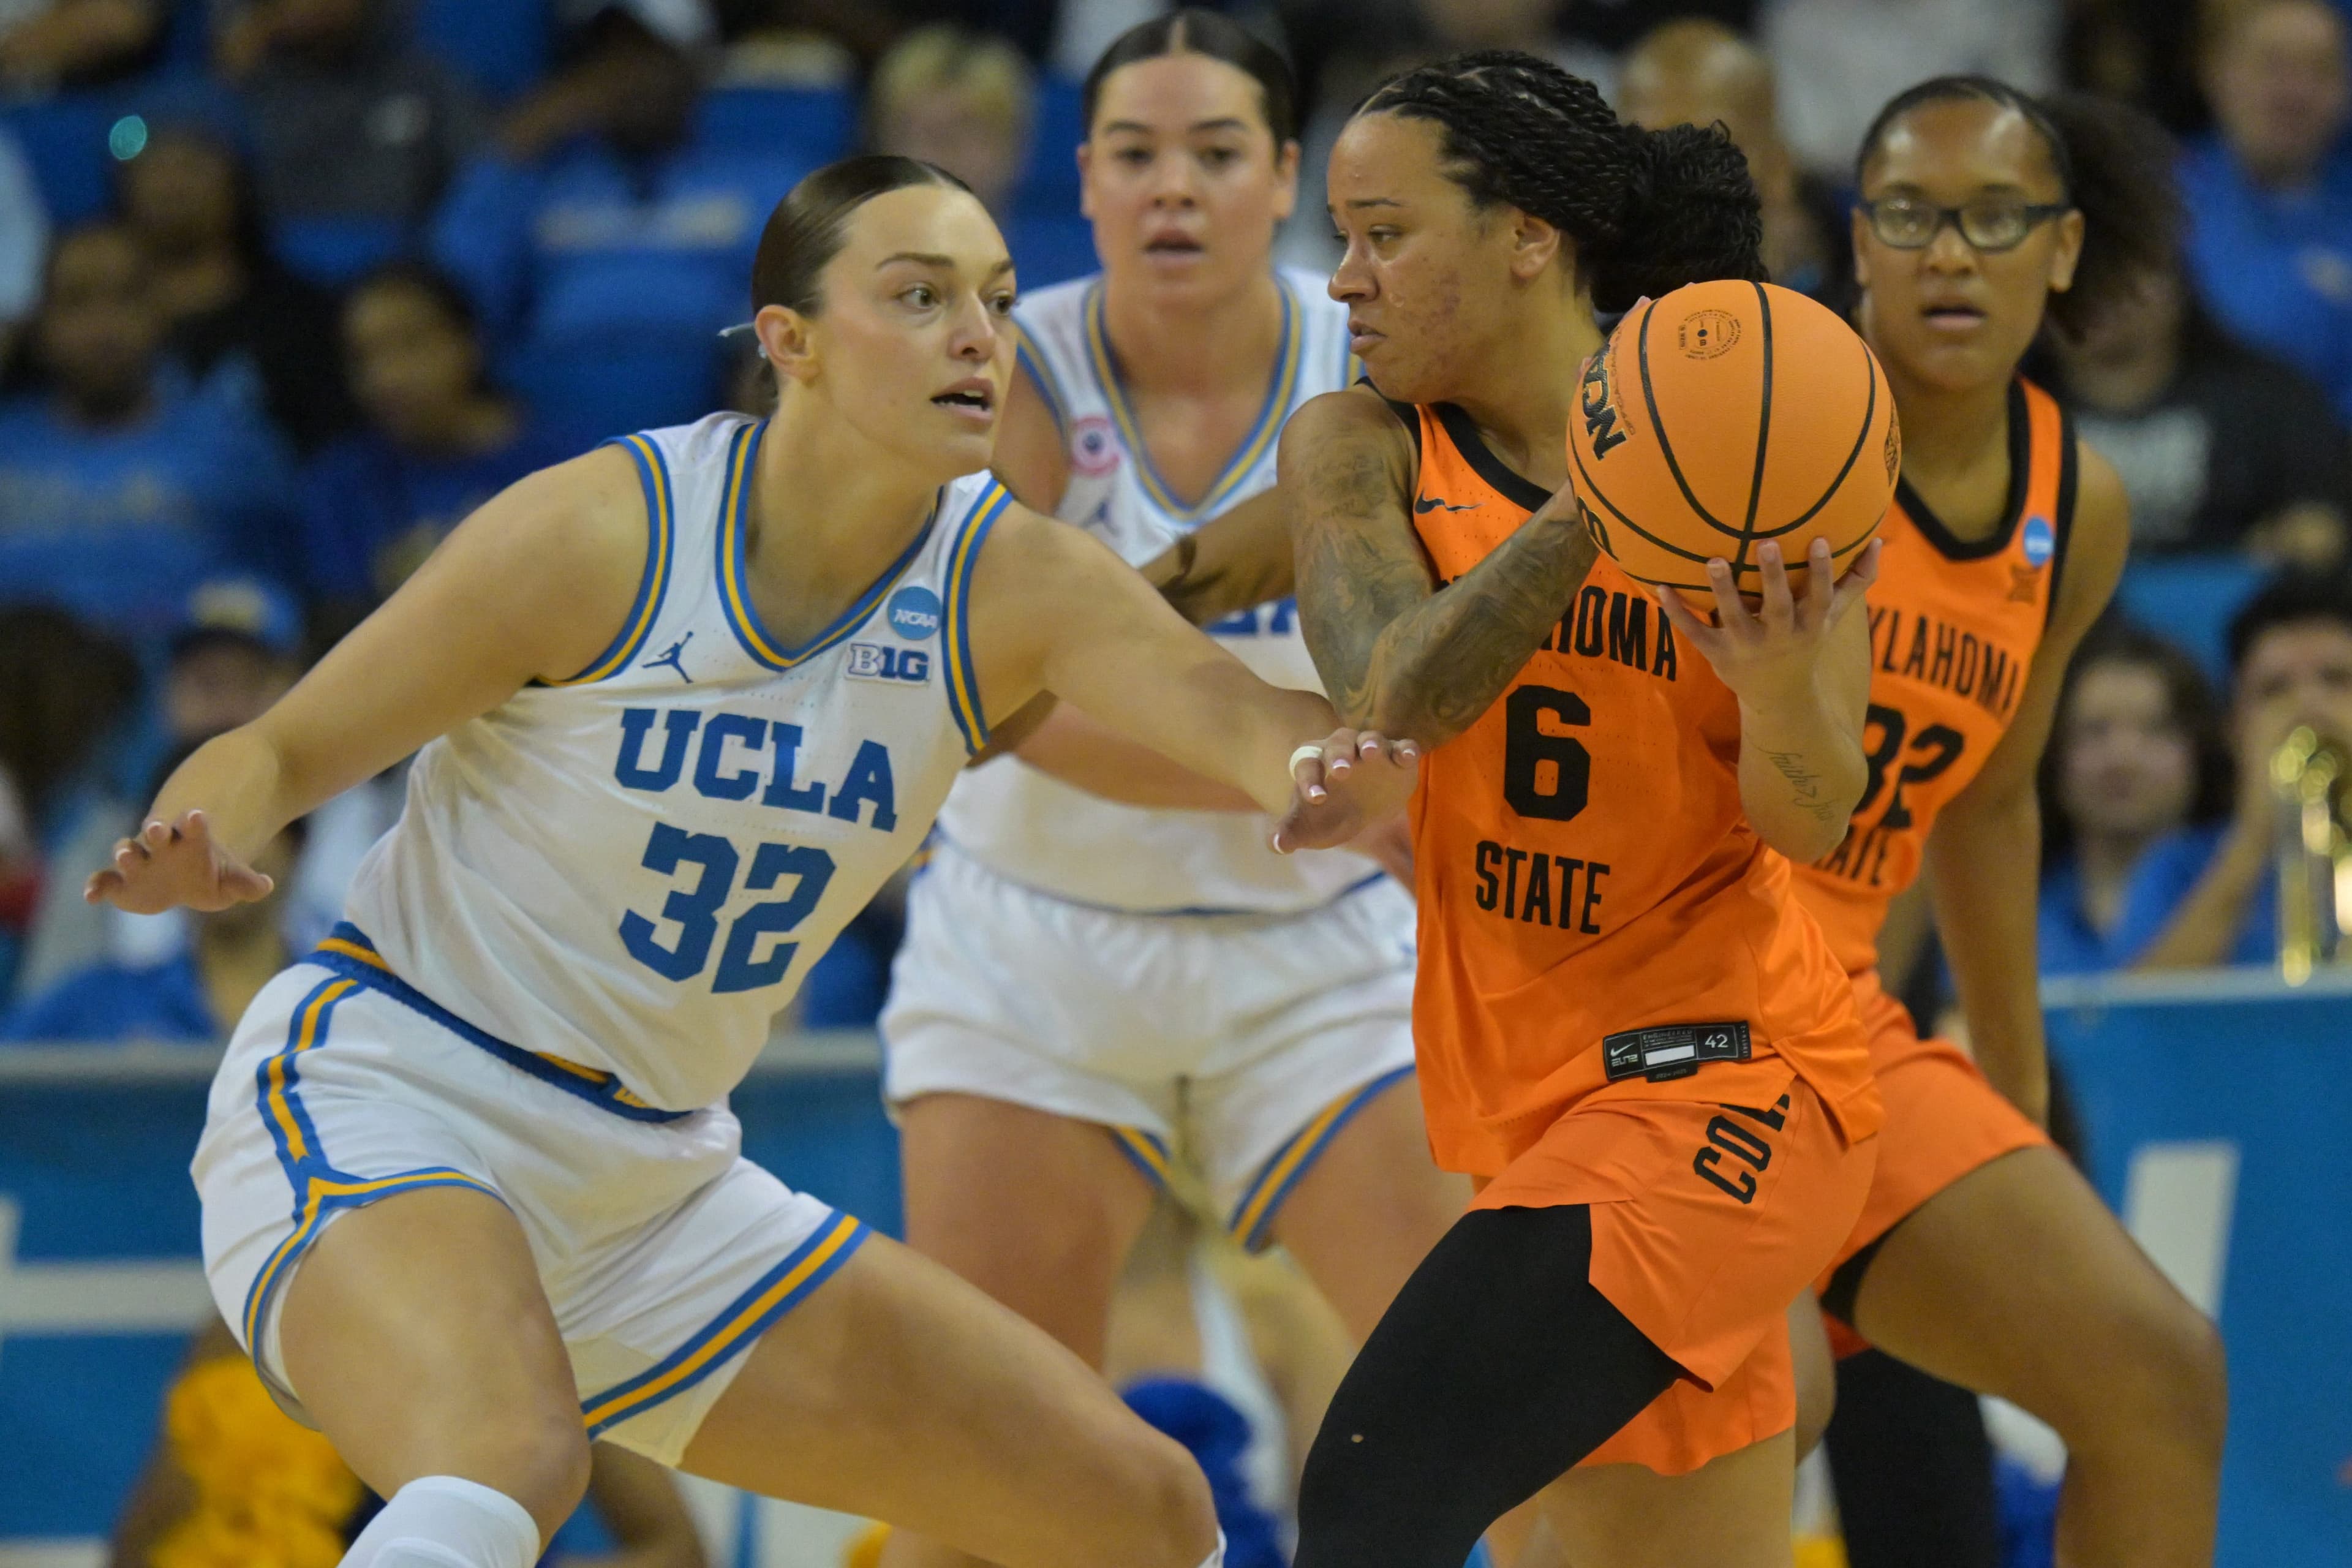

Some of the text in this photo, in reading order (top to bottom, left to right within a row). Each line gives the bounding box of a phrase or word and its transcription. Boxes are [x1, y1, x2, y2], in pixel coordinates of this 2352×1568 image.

[614, 708, 897, 833] UCLA
[1504, 684, 1591, 822] 6
[618, 821, 837, 993] 32
[1476, 839, 1610, 935] STATE
[1705, 1034, 1728, 1049] 42
